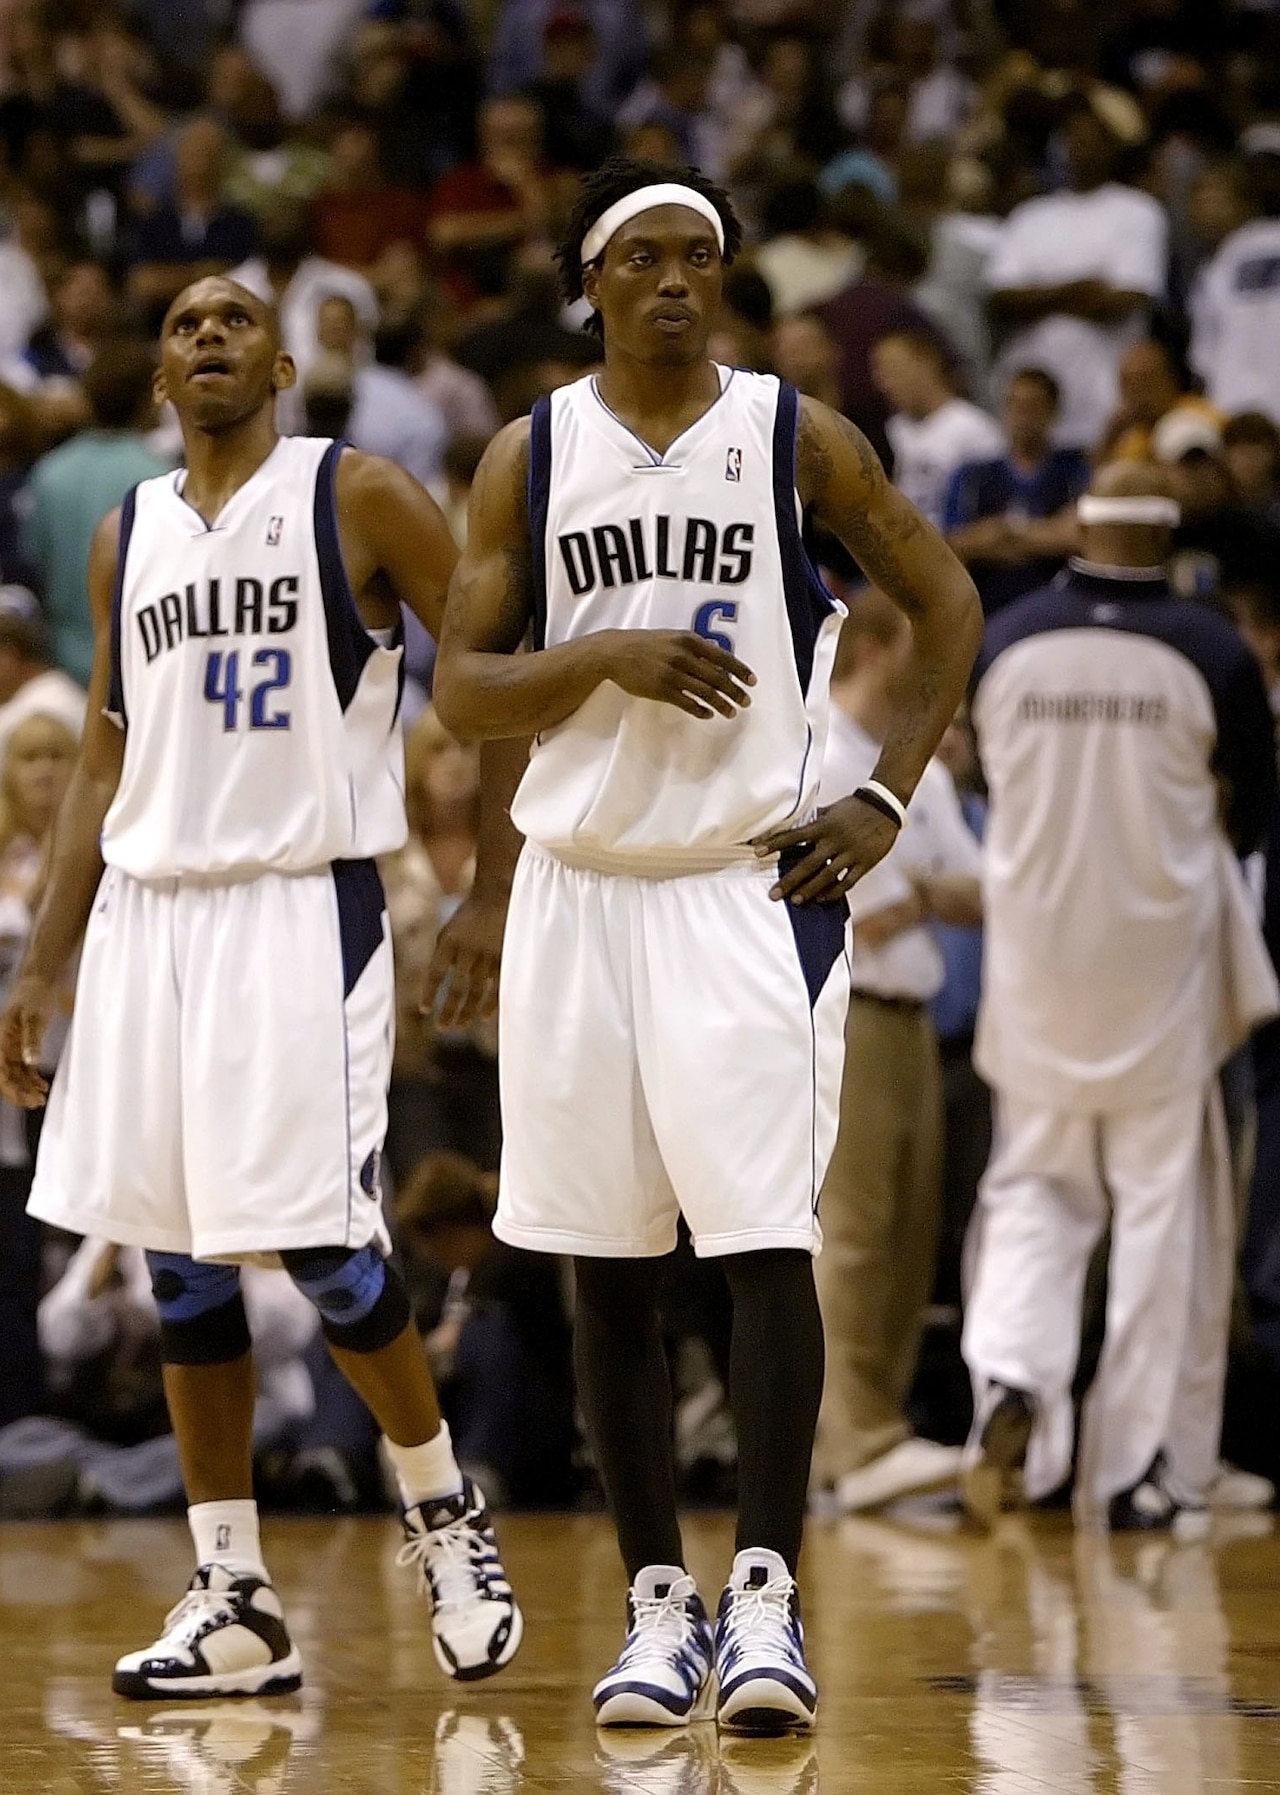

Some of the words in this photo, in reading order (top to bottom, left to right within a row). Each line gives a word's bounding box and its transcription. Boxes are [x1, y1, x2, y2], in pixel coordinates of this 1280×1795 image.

[558, 514, 755, 597] DALLAS
[136, 576, 299, 666] DALLAS
[204, 648, 291, 732] 42
